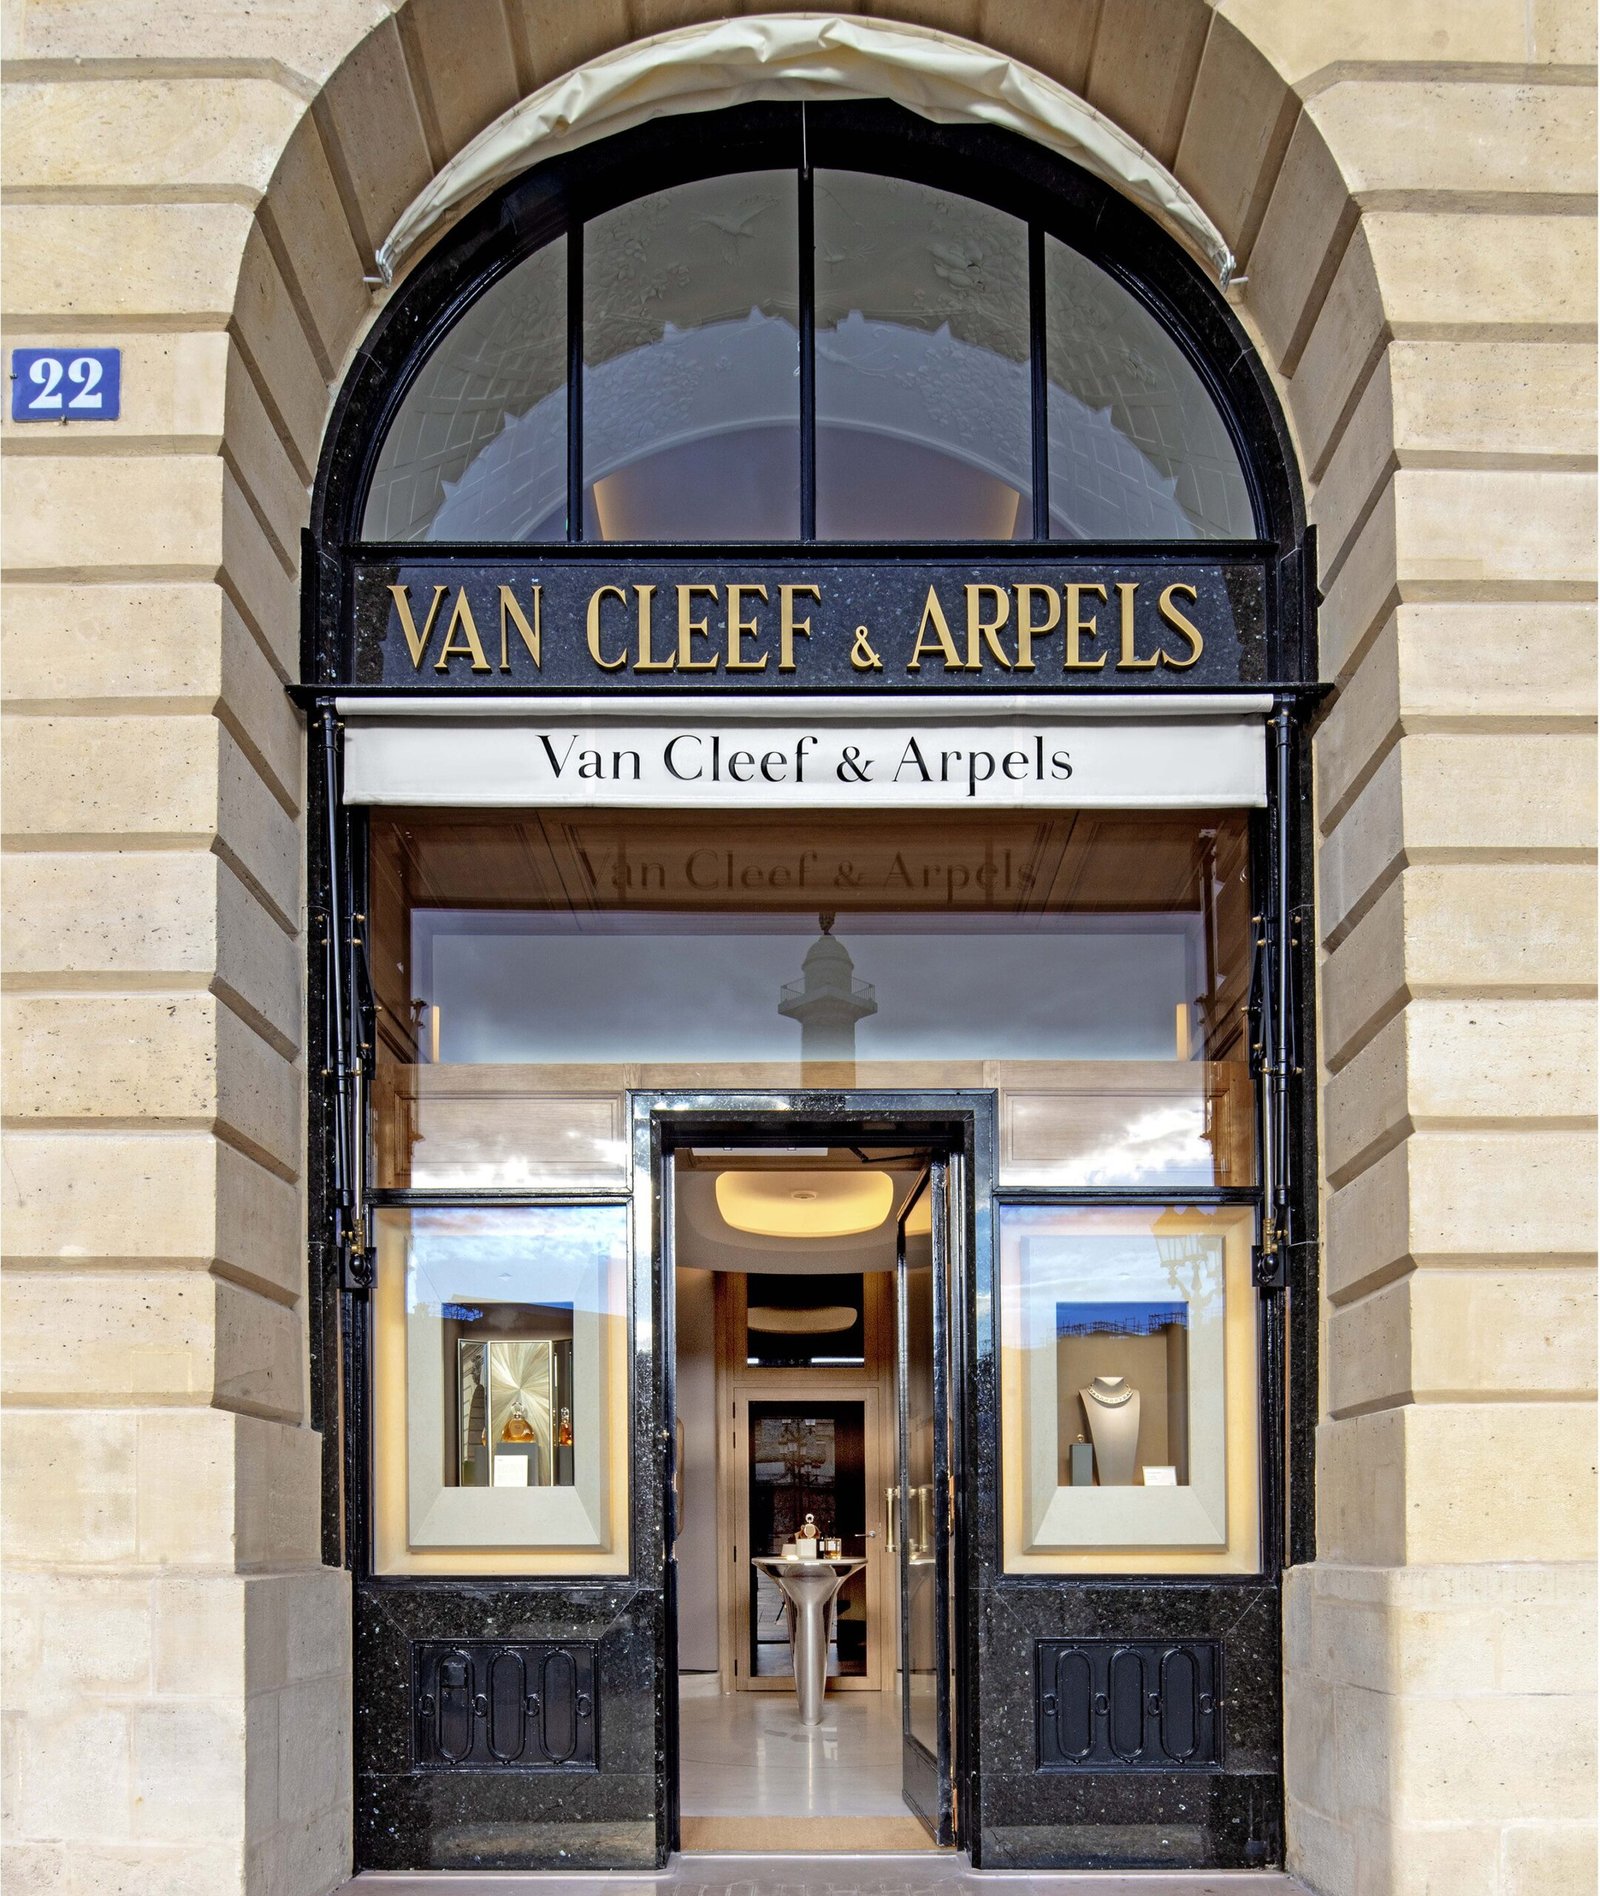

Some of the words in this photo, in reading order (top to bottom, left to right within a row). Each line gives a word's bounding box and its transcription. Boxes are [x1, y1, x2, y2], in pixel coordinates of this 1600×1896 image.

[28, 357, 103, 409] 22
[386, 584, 544, 672] VAN
[586, 583, 822, 672] CLEEF
[850, 625, 884, 671] &
[906, 583, 1204, 671] ARPELS
[535, 734, 642, 781] Van
[663, 734, 819, 783] Cleef
[836, 745, 876, 783] &
[892, 735, 1074, 797] Arpels
[685, 848, 818, 890] Cleef
[833, 860, 864, 890] &
[883, 849, 1036, 904] Arpels
